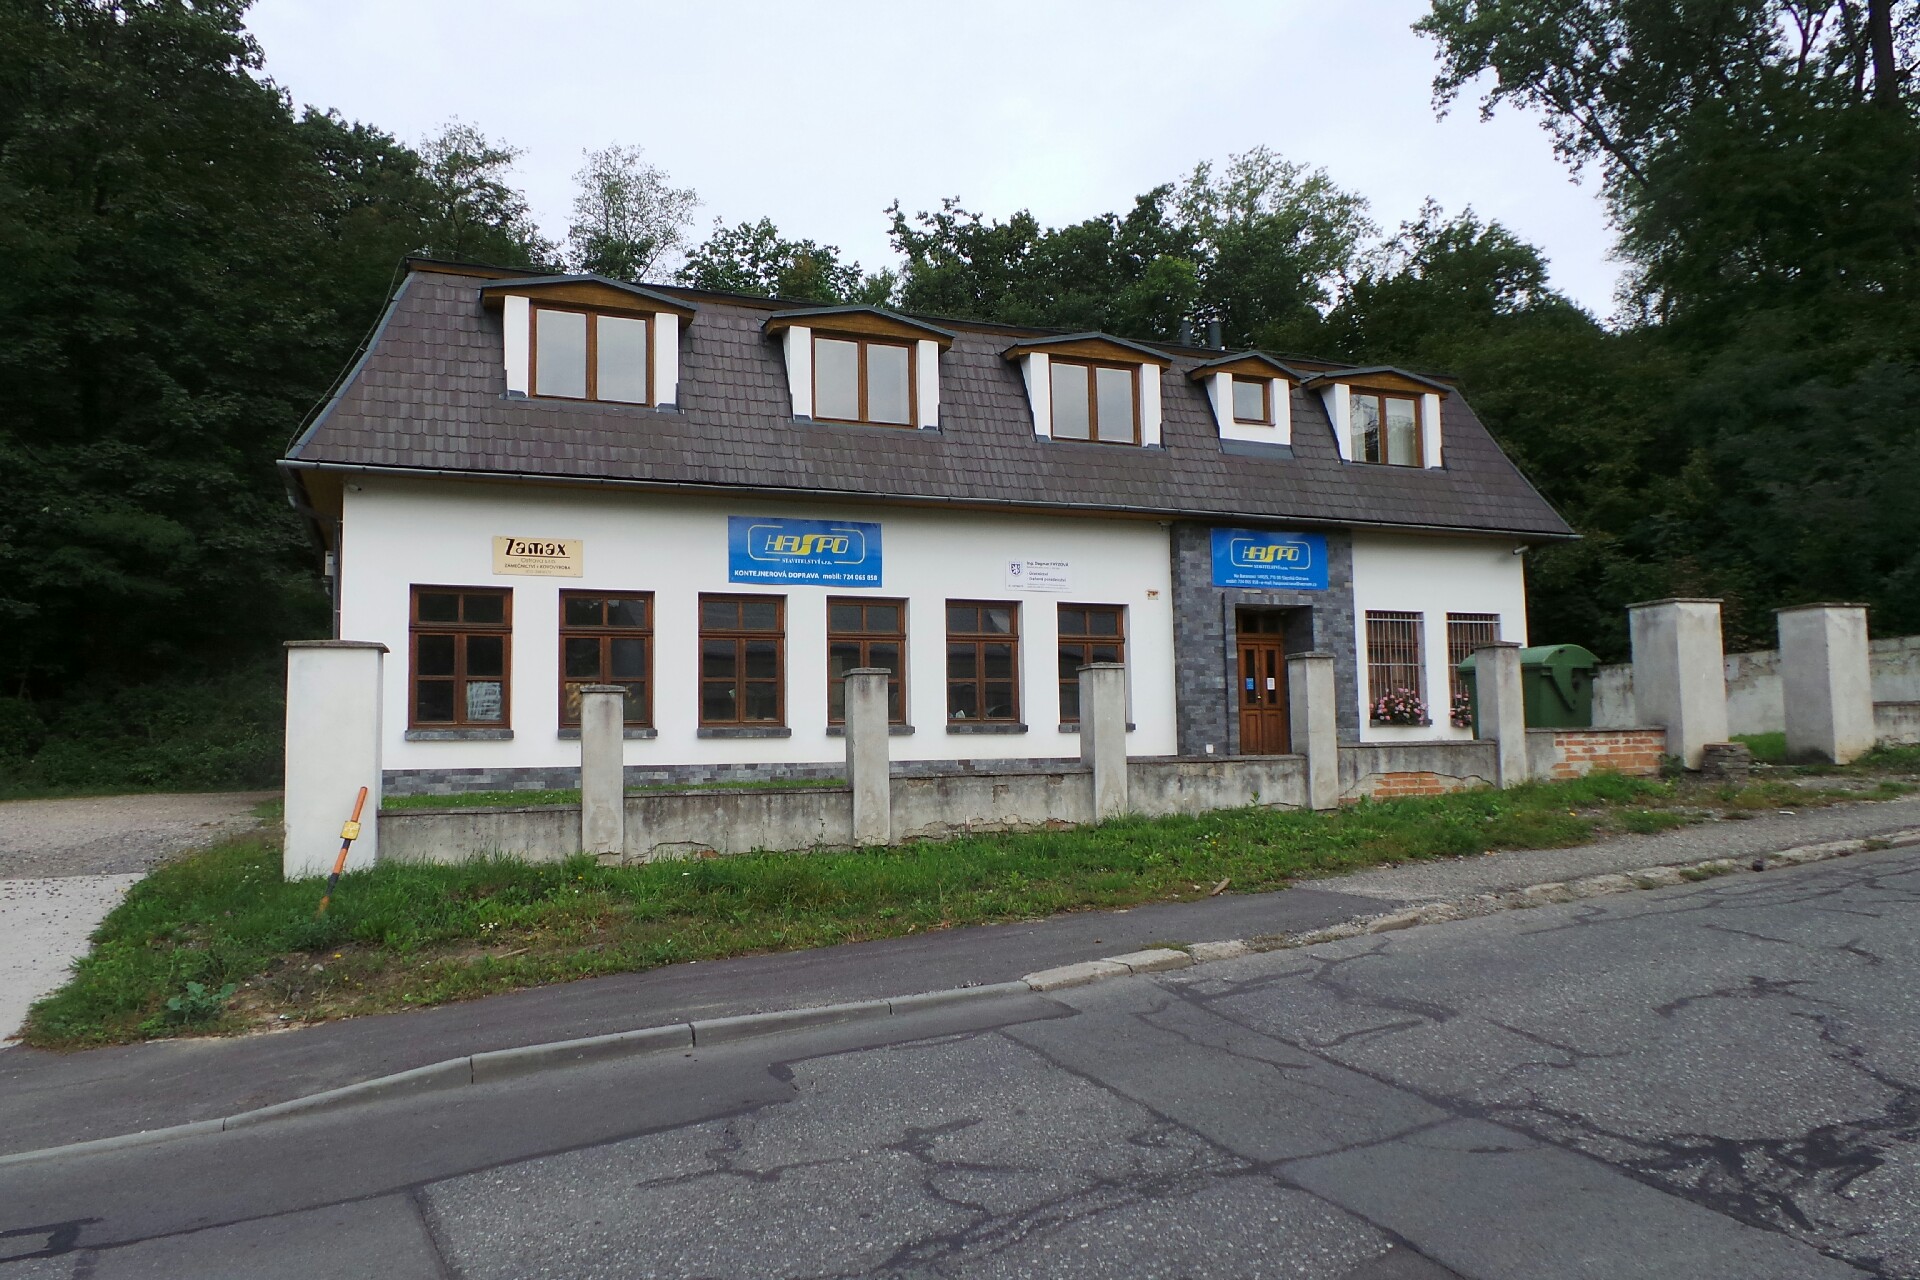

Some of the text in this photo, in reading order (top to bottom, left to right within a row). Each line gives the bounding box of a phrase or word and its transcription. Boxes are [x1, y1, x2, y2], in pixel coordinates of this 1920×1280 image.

[505, 538, 566, 556] Zamax
[765, 534, 849, 555] HASPO
[1242, 545, 1300, 563] HASPO
[734, 570, 787, 578] KONTEJNEROVÁ
